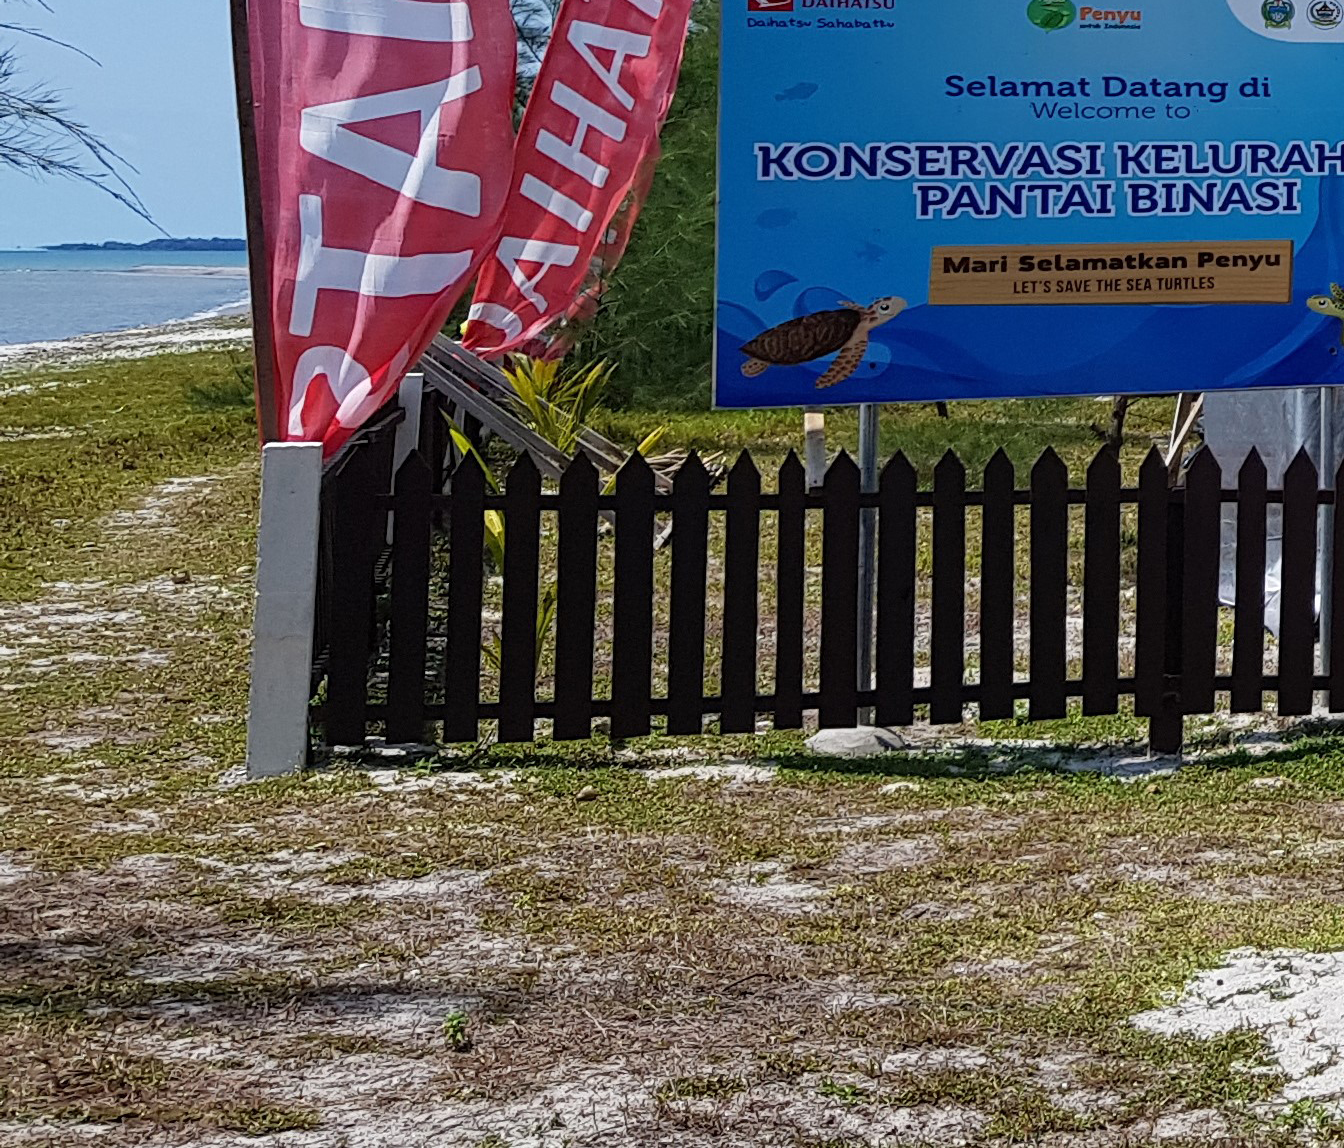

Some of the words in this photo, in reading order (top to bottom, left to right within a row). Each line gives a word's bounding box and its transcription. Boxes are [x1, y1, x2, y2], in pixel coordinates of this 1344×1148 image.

[747, 17, 812, 28] Daihatsu
[1080, 7, 1141, 24] Penyu
[945, 75, 1089, 98] Selamat
[1103, 76, 1228, 104] Datang
[1239, 76, 1271, 98] di
[1032, 101, 1158, 119] Welcome
[1165, 103, 1190, 119] to
[757, 143, 1105, 179] KONSERVASI
[919, 182, 1115, 218] PANTAI
[1127, 178, 1300, 214] BINASI
[942, 257, 1008, 275] Mari
[1019, 252, 1188, 274] Selamatkan
[1198, 249, 1281, 274] Penyu
[1013, 279, 1052, 294] LET'S
[1056, 278, 1092, 294] SAVE
[1097, 277, 1122, 293] THE
[1127, 277, 1152, 293] SEA
[1157, 276, 1216, 292] TURTLES
